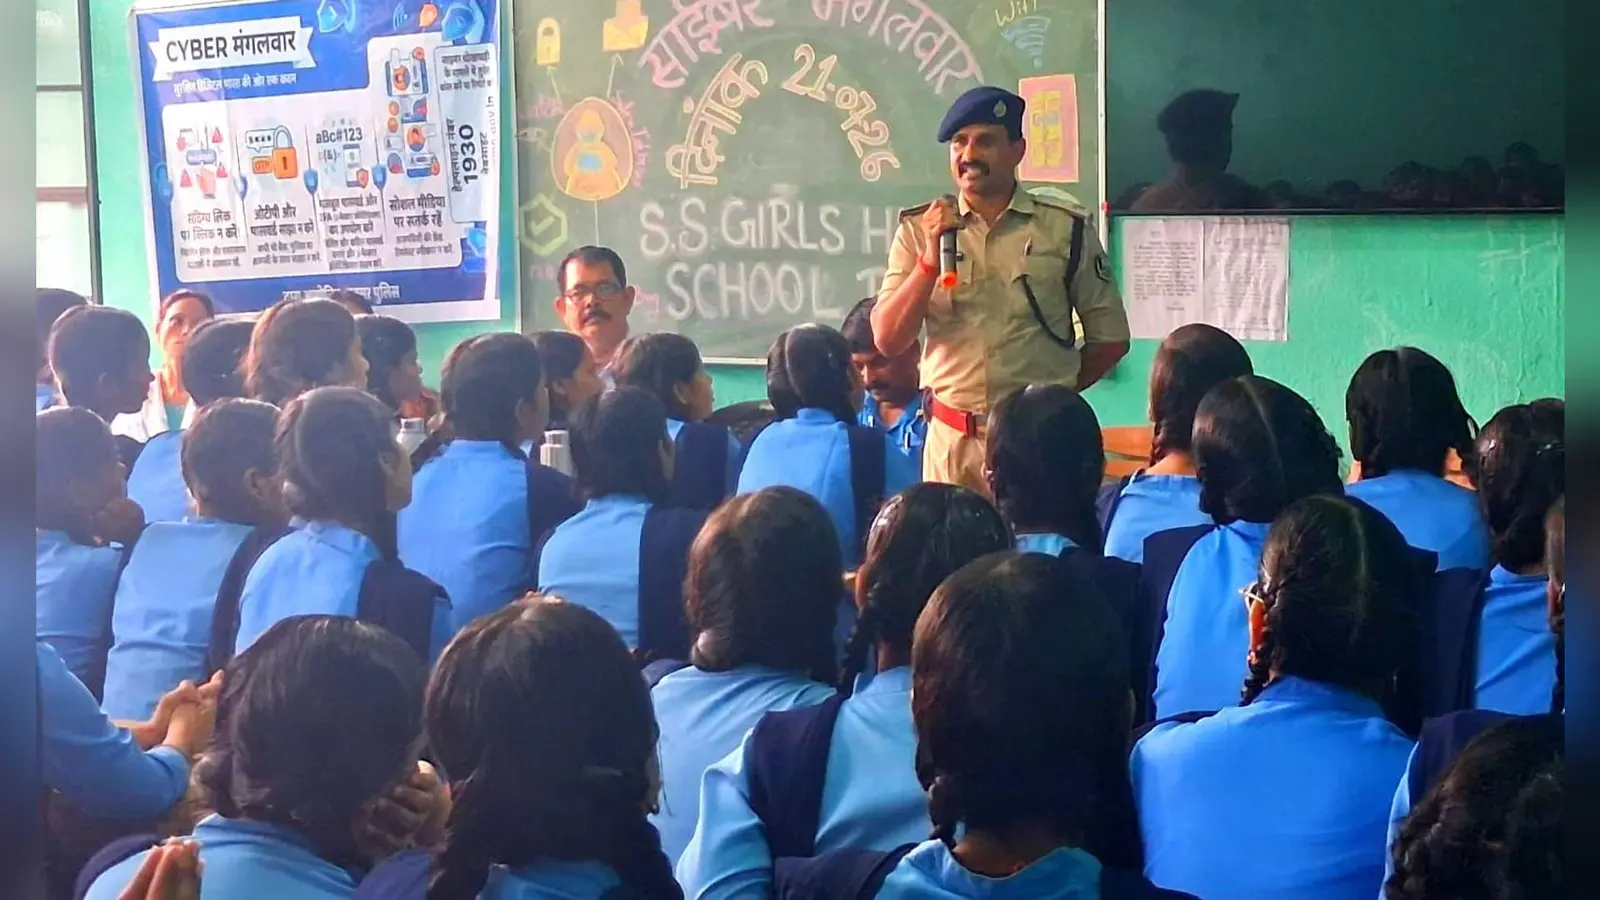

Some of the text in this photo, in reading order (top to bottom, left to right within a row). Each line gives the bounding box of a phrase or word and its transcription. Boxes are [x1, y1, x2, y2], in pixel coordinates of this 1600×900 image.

[166, 29, 296, 62] CYBER मंगलवार
[811, 0, 985, 94] मगलवार
[316, 127, 363, 144] aBc#123
[665, 52, 768, 189] दिनांक
[458, 124, 479, 185] 1930
[254, 202, 296, 220] ओटीपी और
[389, 193, 446, 211] सोशल मीडिया
[394, 215, 404, 228] पर
[721, 196, 846, 254] GIRLS
[666, 261, 844, 320] SCHOOL
